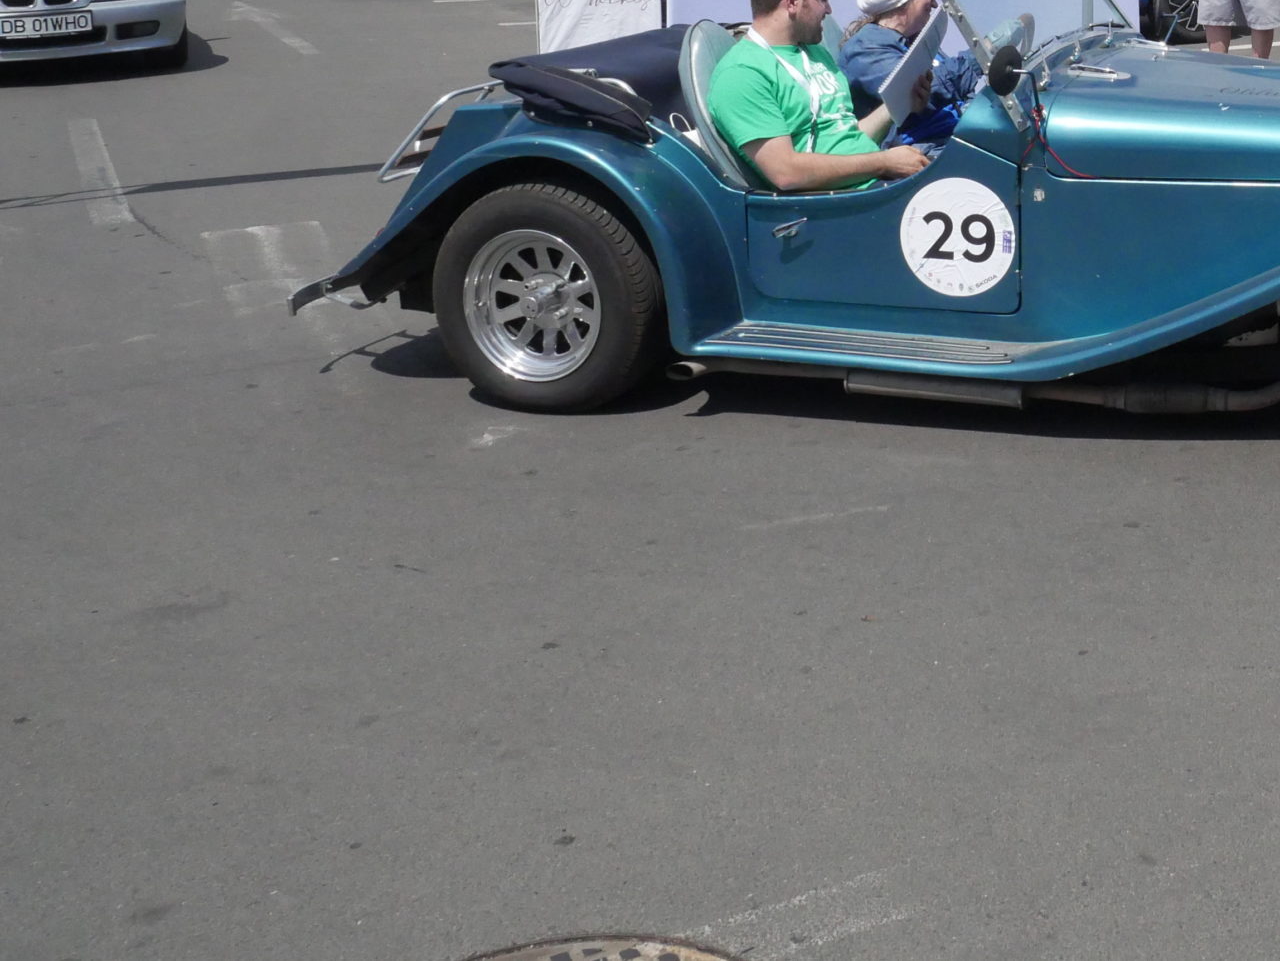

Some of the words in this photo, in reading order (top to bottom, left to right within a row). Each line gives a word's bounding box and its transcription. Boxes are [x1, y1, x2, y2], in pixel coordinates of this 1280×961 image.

[1, 19, 26, 34] DB
[32, 15, 89, 32] 01WHO
[922, 210, 996, 264] 29
